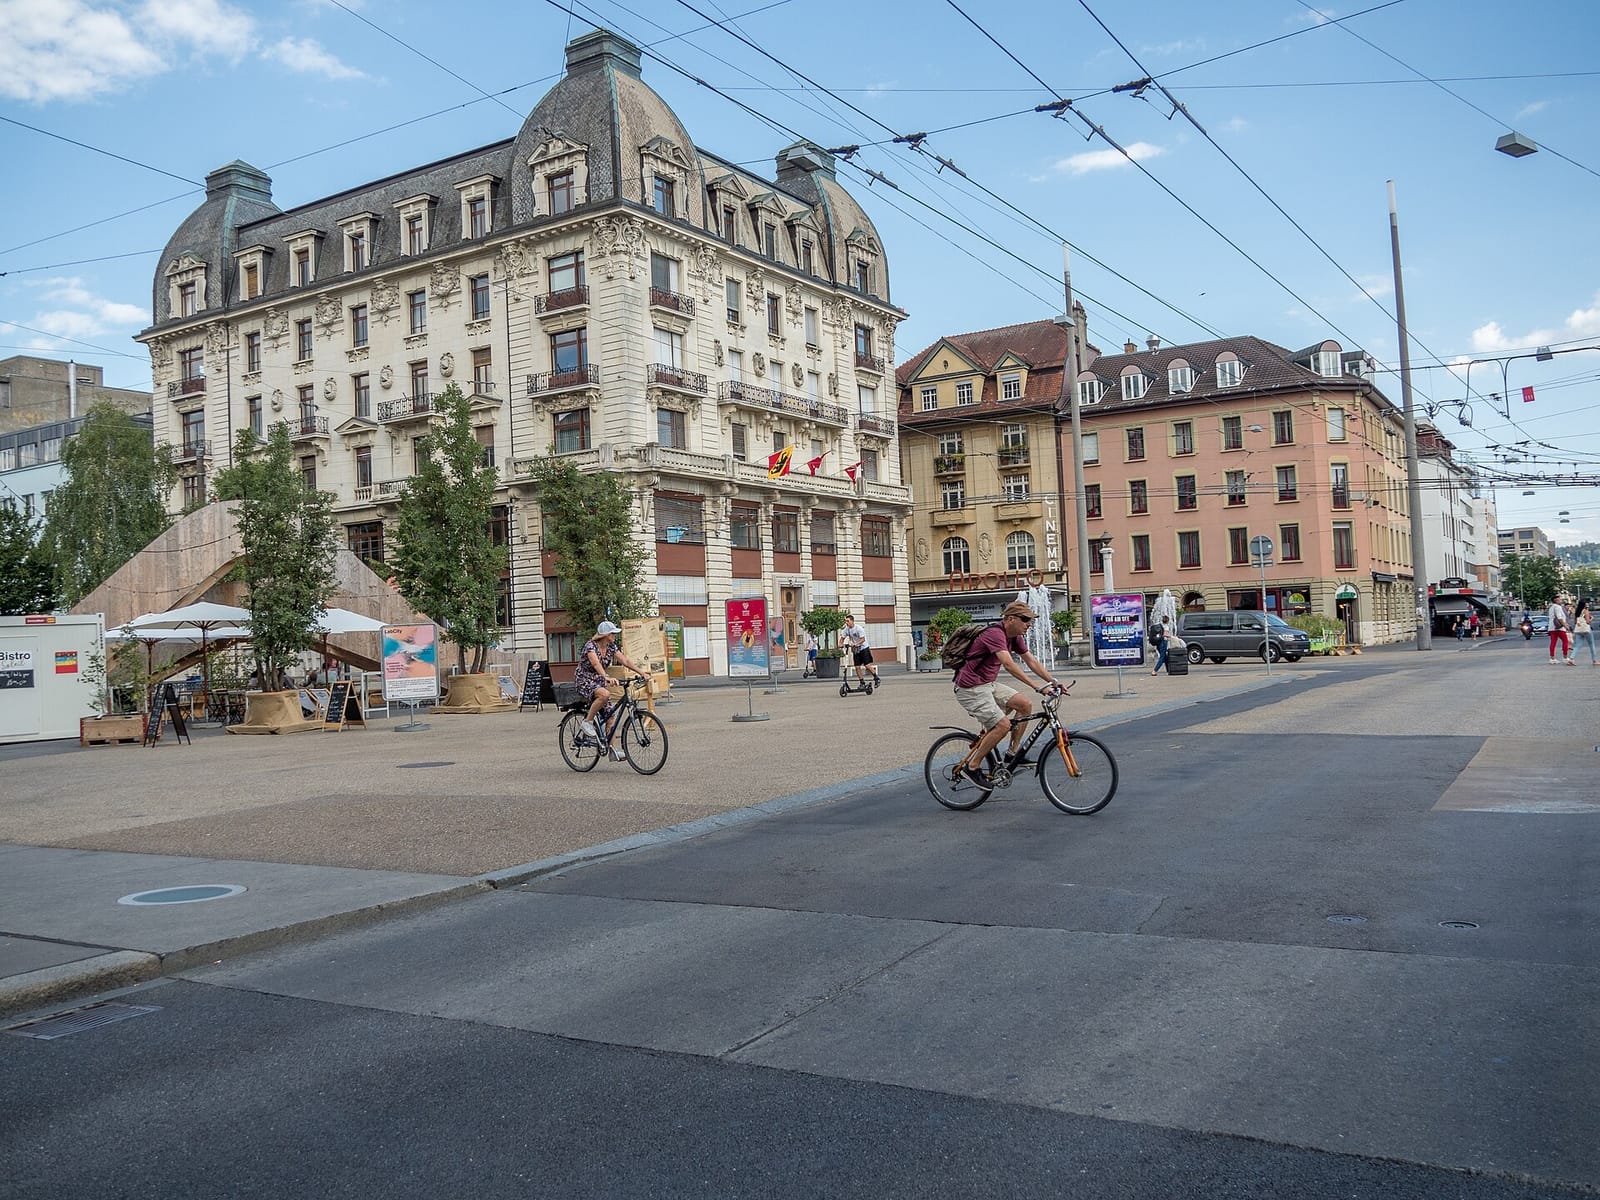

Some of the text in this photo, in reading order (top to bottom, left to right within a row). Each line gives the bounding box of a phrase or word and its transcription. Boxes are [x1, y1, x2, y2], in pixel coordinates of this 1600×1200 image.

[1044, 493, 1058, 571] CINEMA
[949, 569, 1044, 591] APOLLO
[0, 651, 31, 660] Bistro
